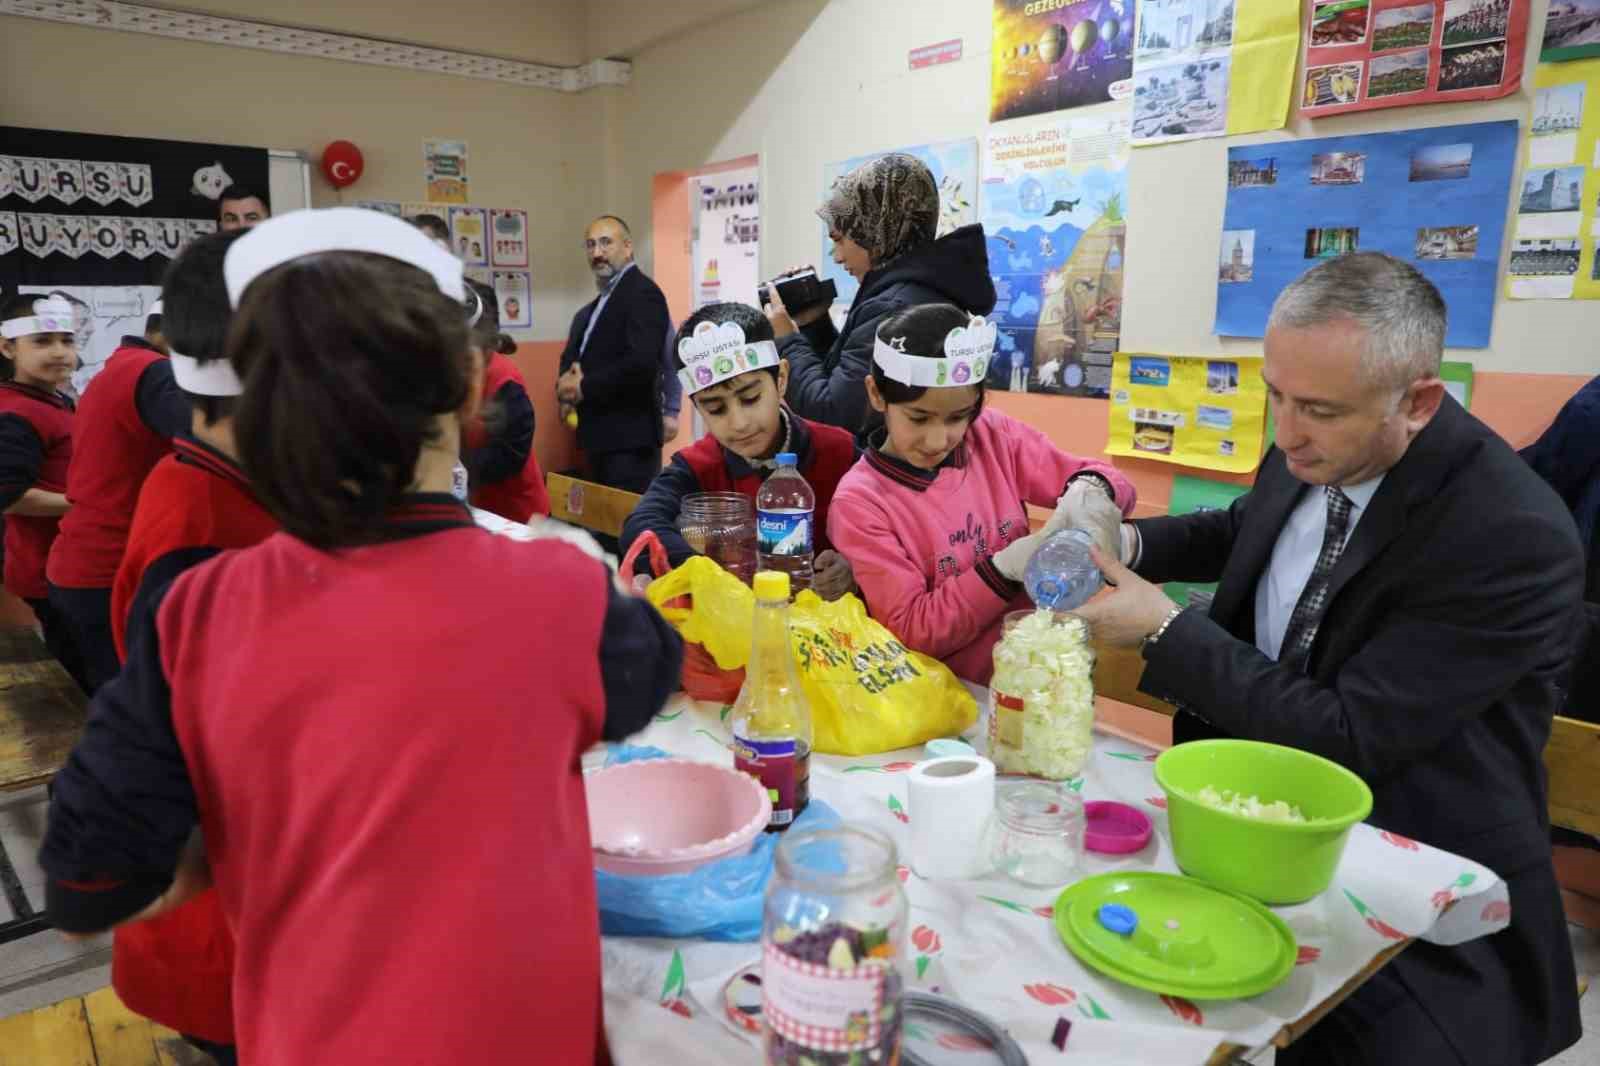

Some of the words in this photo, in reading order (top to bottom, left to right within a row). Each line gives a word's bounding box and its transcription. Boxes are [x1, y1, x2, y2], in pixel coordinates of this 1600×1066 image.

[0, 168, 144, 196] URSU
[0, 224, 208, 249] RUYORU
[760, 517, 787, 532] desni
[948, 512, 985, 546] only
